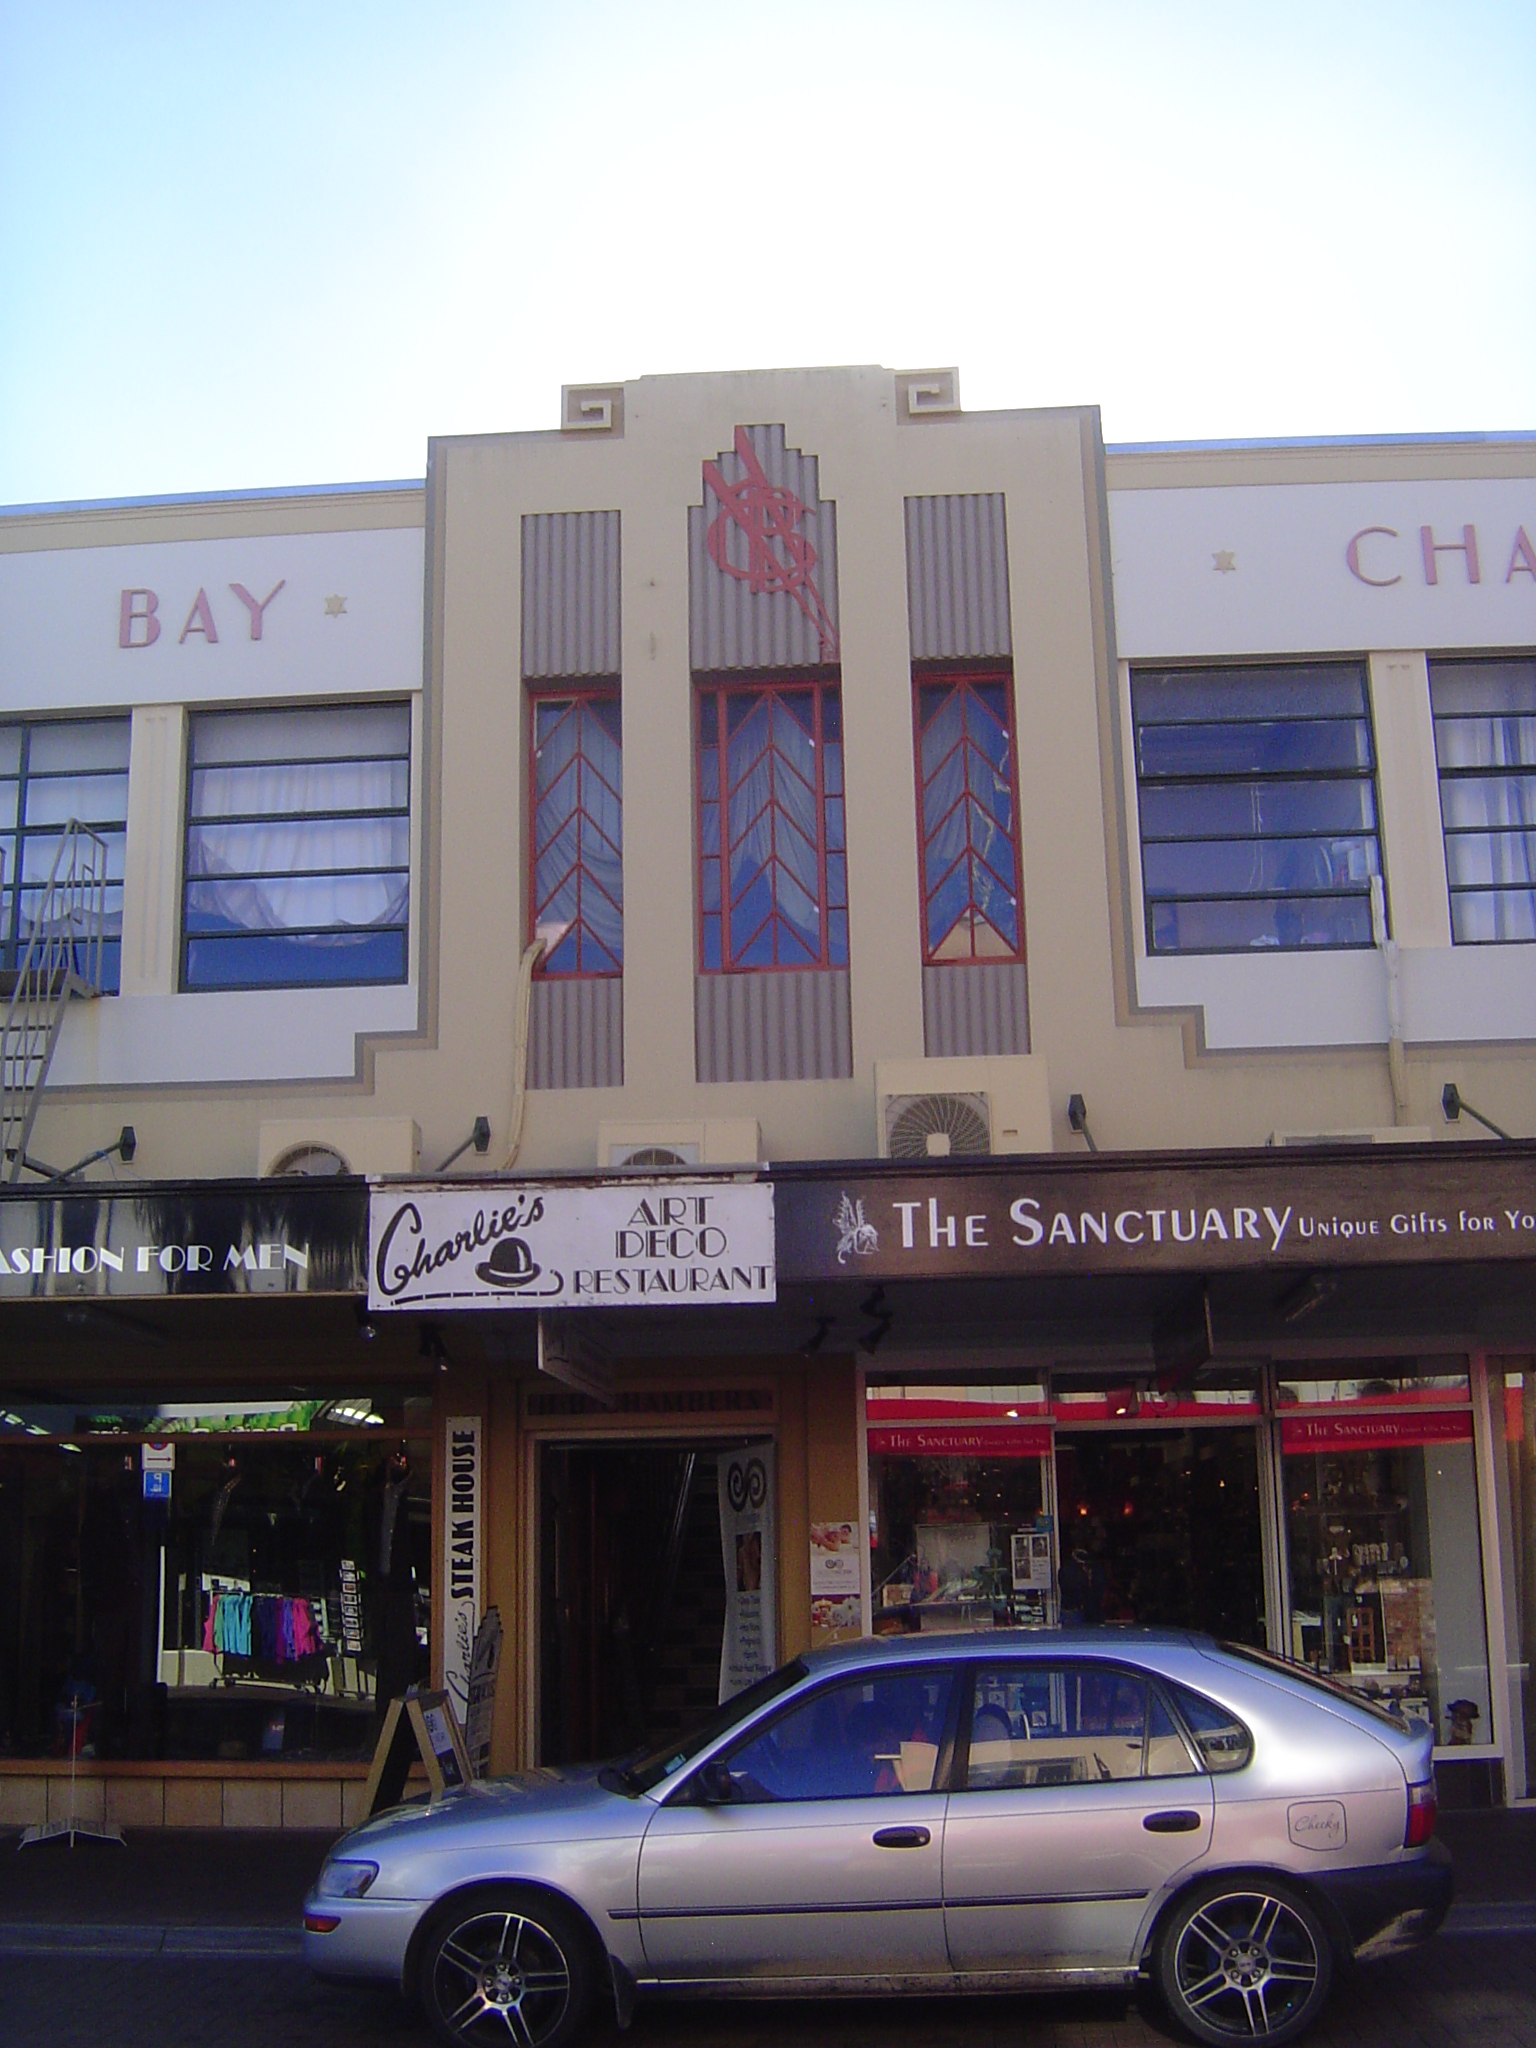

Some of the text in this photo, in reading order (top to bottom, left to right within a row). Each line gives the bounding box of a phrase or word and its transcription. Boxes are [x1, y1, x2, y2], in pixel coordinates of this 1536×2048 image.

[1346, 524, 1536, 587] CHA
[118, 579, 287, 649] BAY
[615, 1226, 727, 1259] DECO
[627, 1196, 714, 1226] ART
[136, 1245, 214, 1272] FOR
[223, 1243, 309, 1271] MEN
[376, 1194, 545, 1296] Charlie's
[573, 1265, 773, 1295] RESTAURANT
[451, 1430, 475, 1513] HOUSE
[451, 1519, 475, 1599] STEAK
